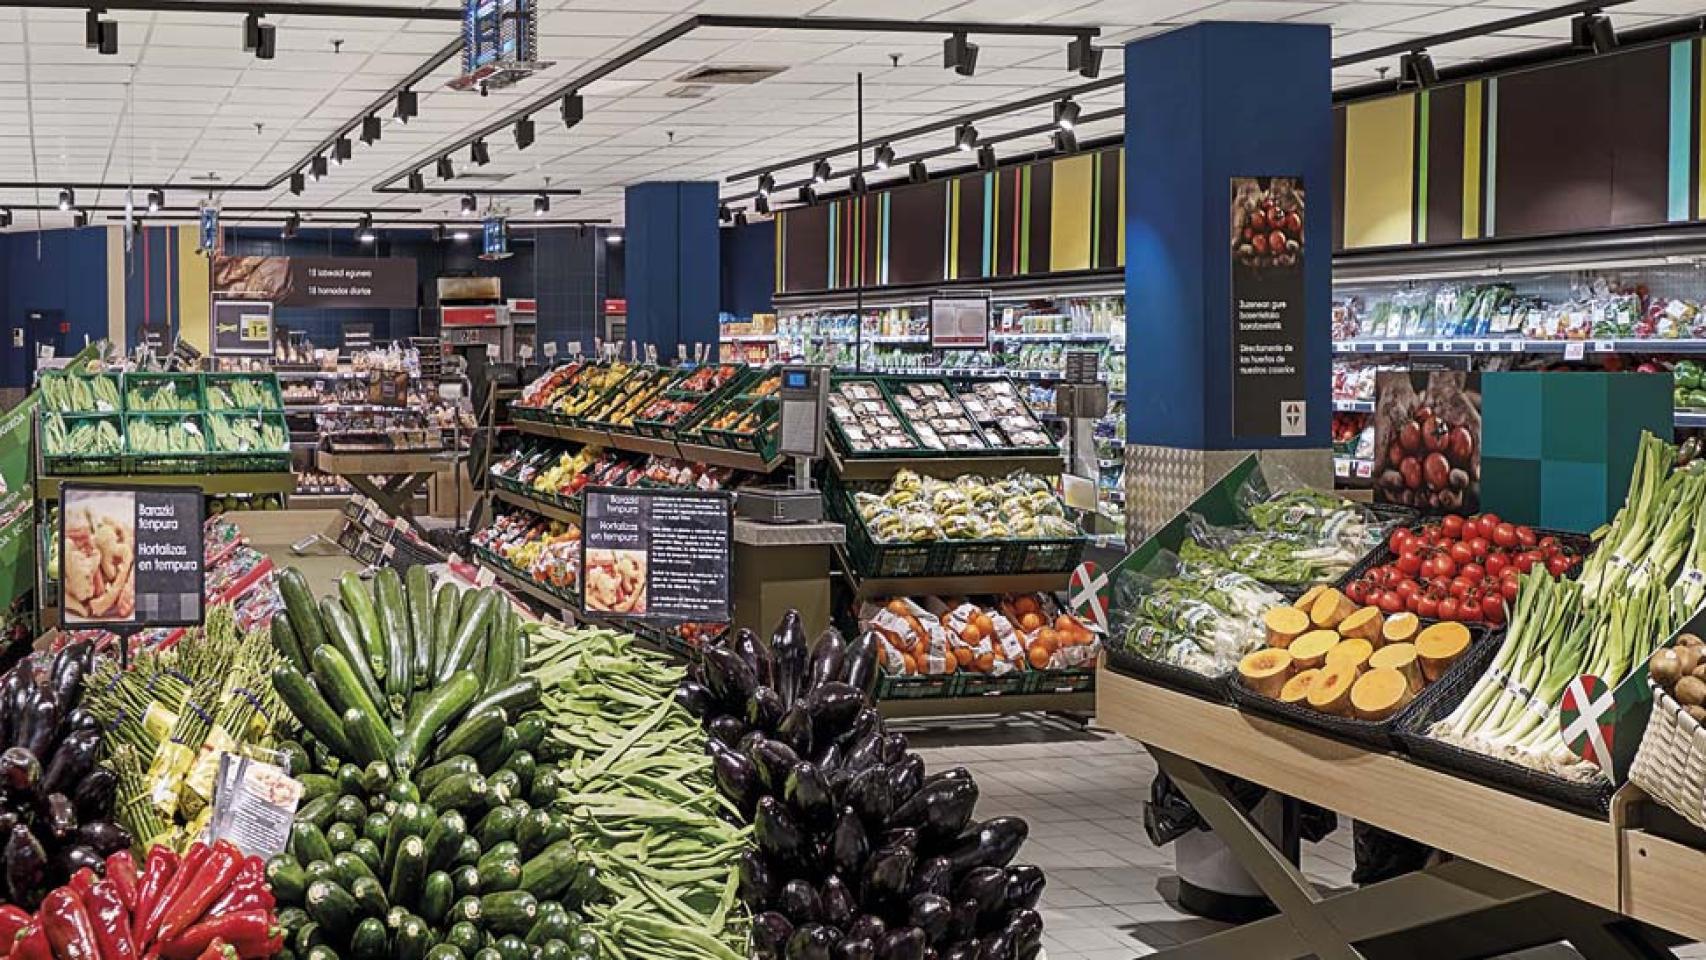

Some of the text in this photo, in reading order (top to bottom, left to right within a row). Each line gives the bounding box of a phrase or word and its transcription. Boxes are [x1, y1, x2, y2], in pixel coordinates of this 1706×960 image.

[138, 502, 175, 517] Barazki
[138, 543, 187, 556] Hortalizas
[138, 558, 198, 574] en tempura
